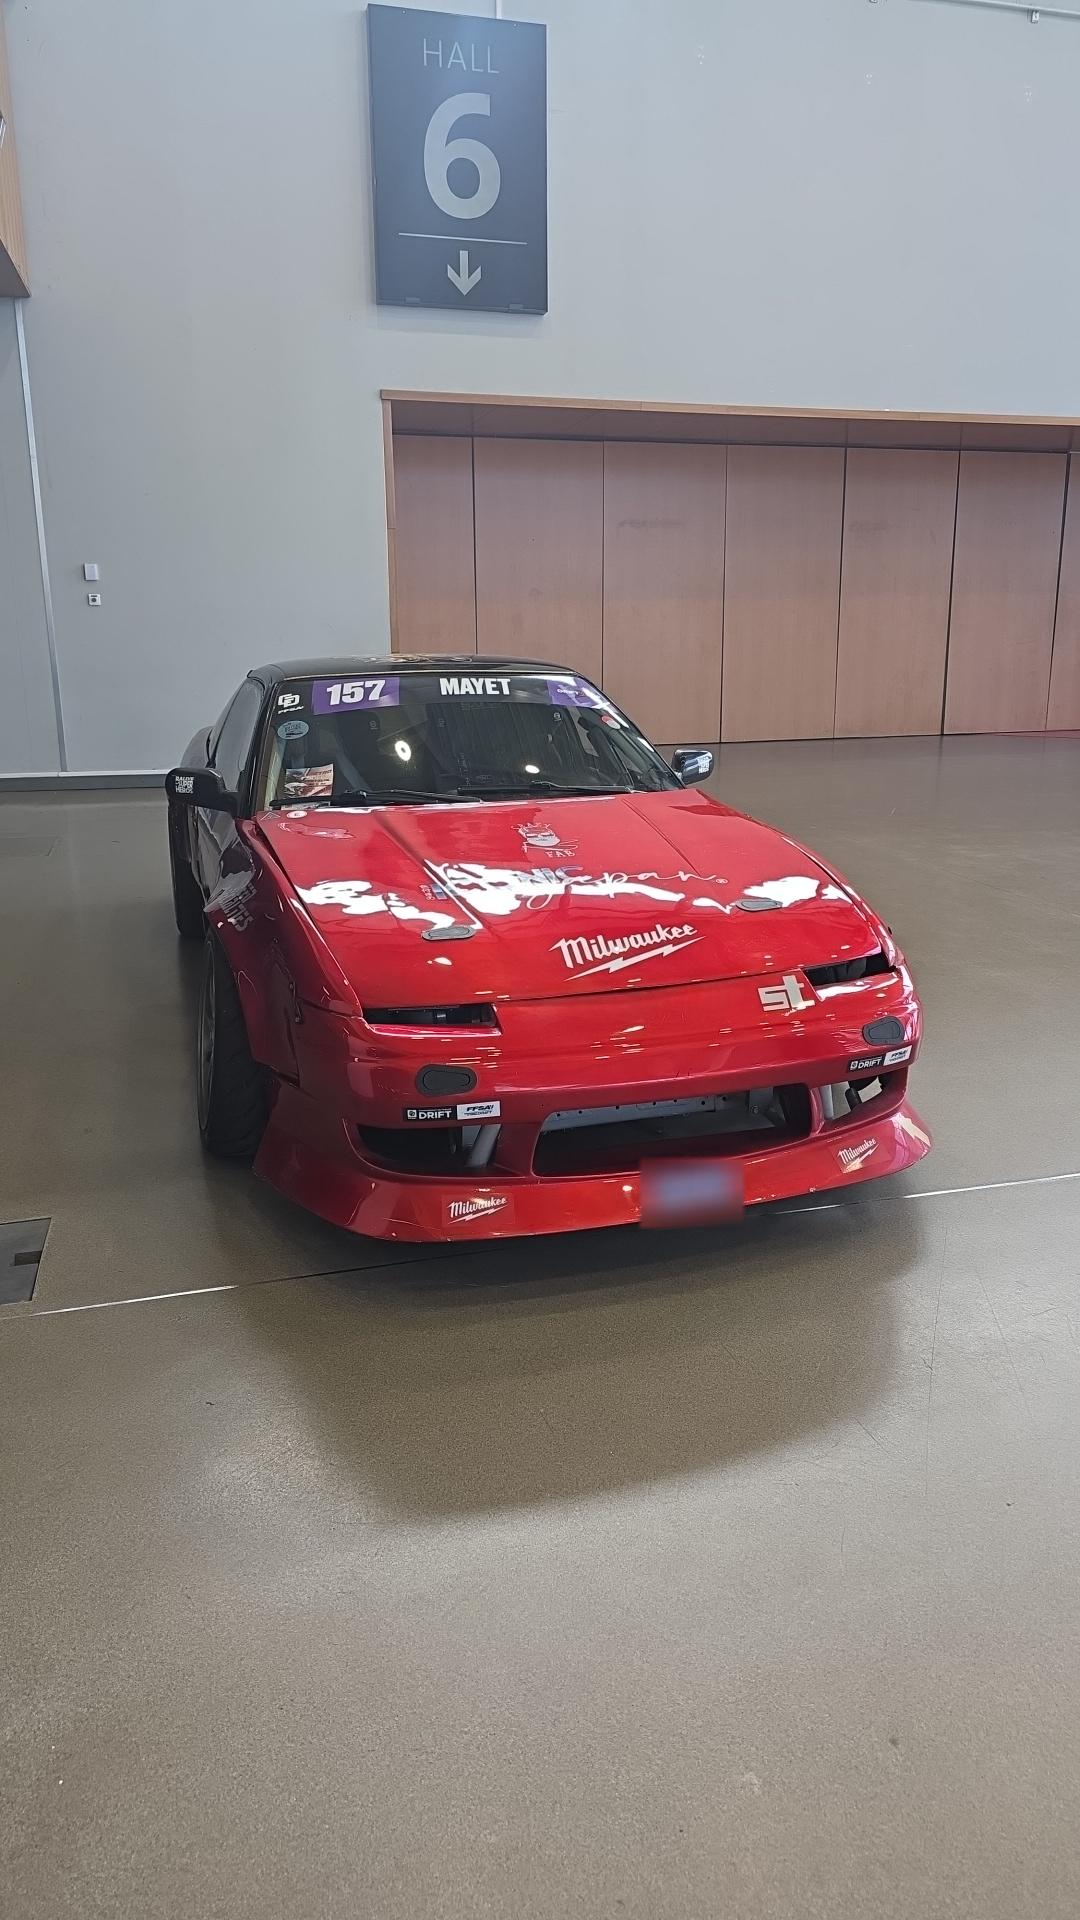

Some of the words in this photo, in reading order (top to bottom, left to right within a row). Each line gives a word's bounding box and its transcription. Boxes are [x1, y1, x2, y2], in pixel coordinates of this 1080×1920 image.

[422, 37, 500, 74] HALL
[423, 92, 501, 220] 6
[326, 679, 386, 706] 157
[439, 677, 511, 696] MAYET
[544, 849, 576, 858] FAB
[547, 923, 699, 969] Milwaukee
[857, 1057, 882, 1069] DRIFT
[418, 1110, 452, 1120] DRIFT
[836, 1138, 878, 1165] Milwaukee
[447, 1196, 508, 1218] Milwaukee
